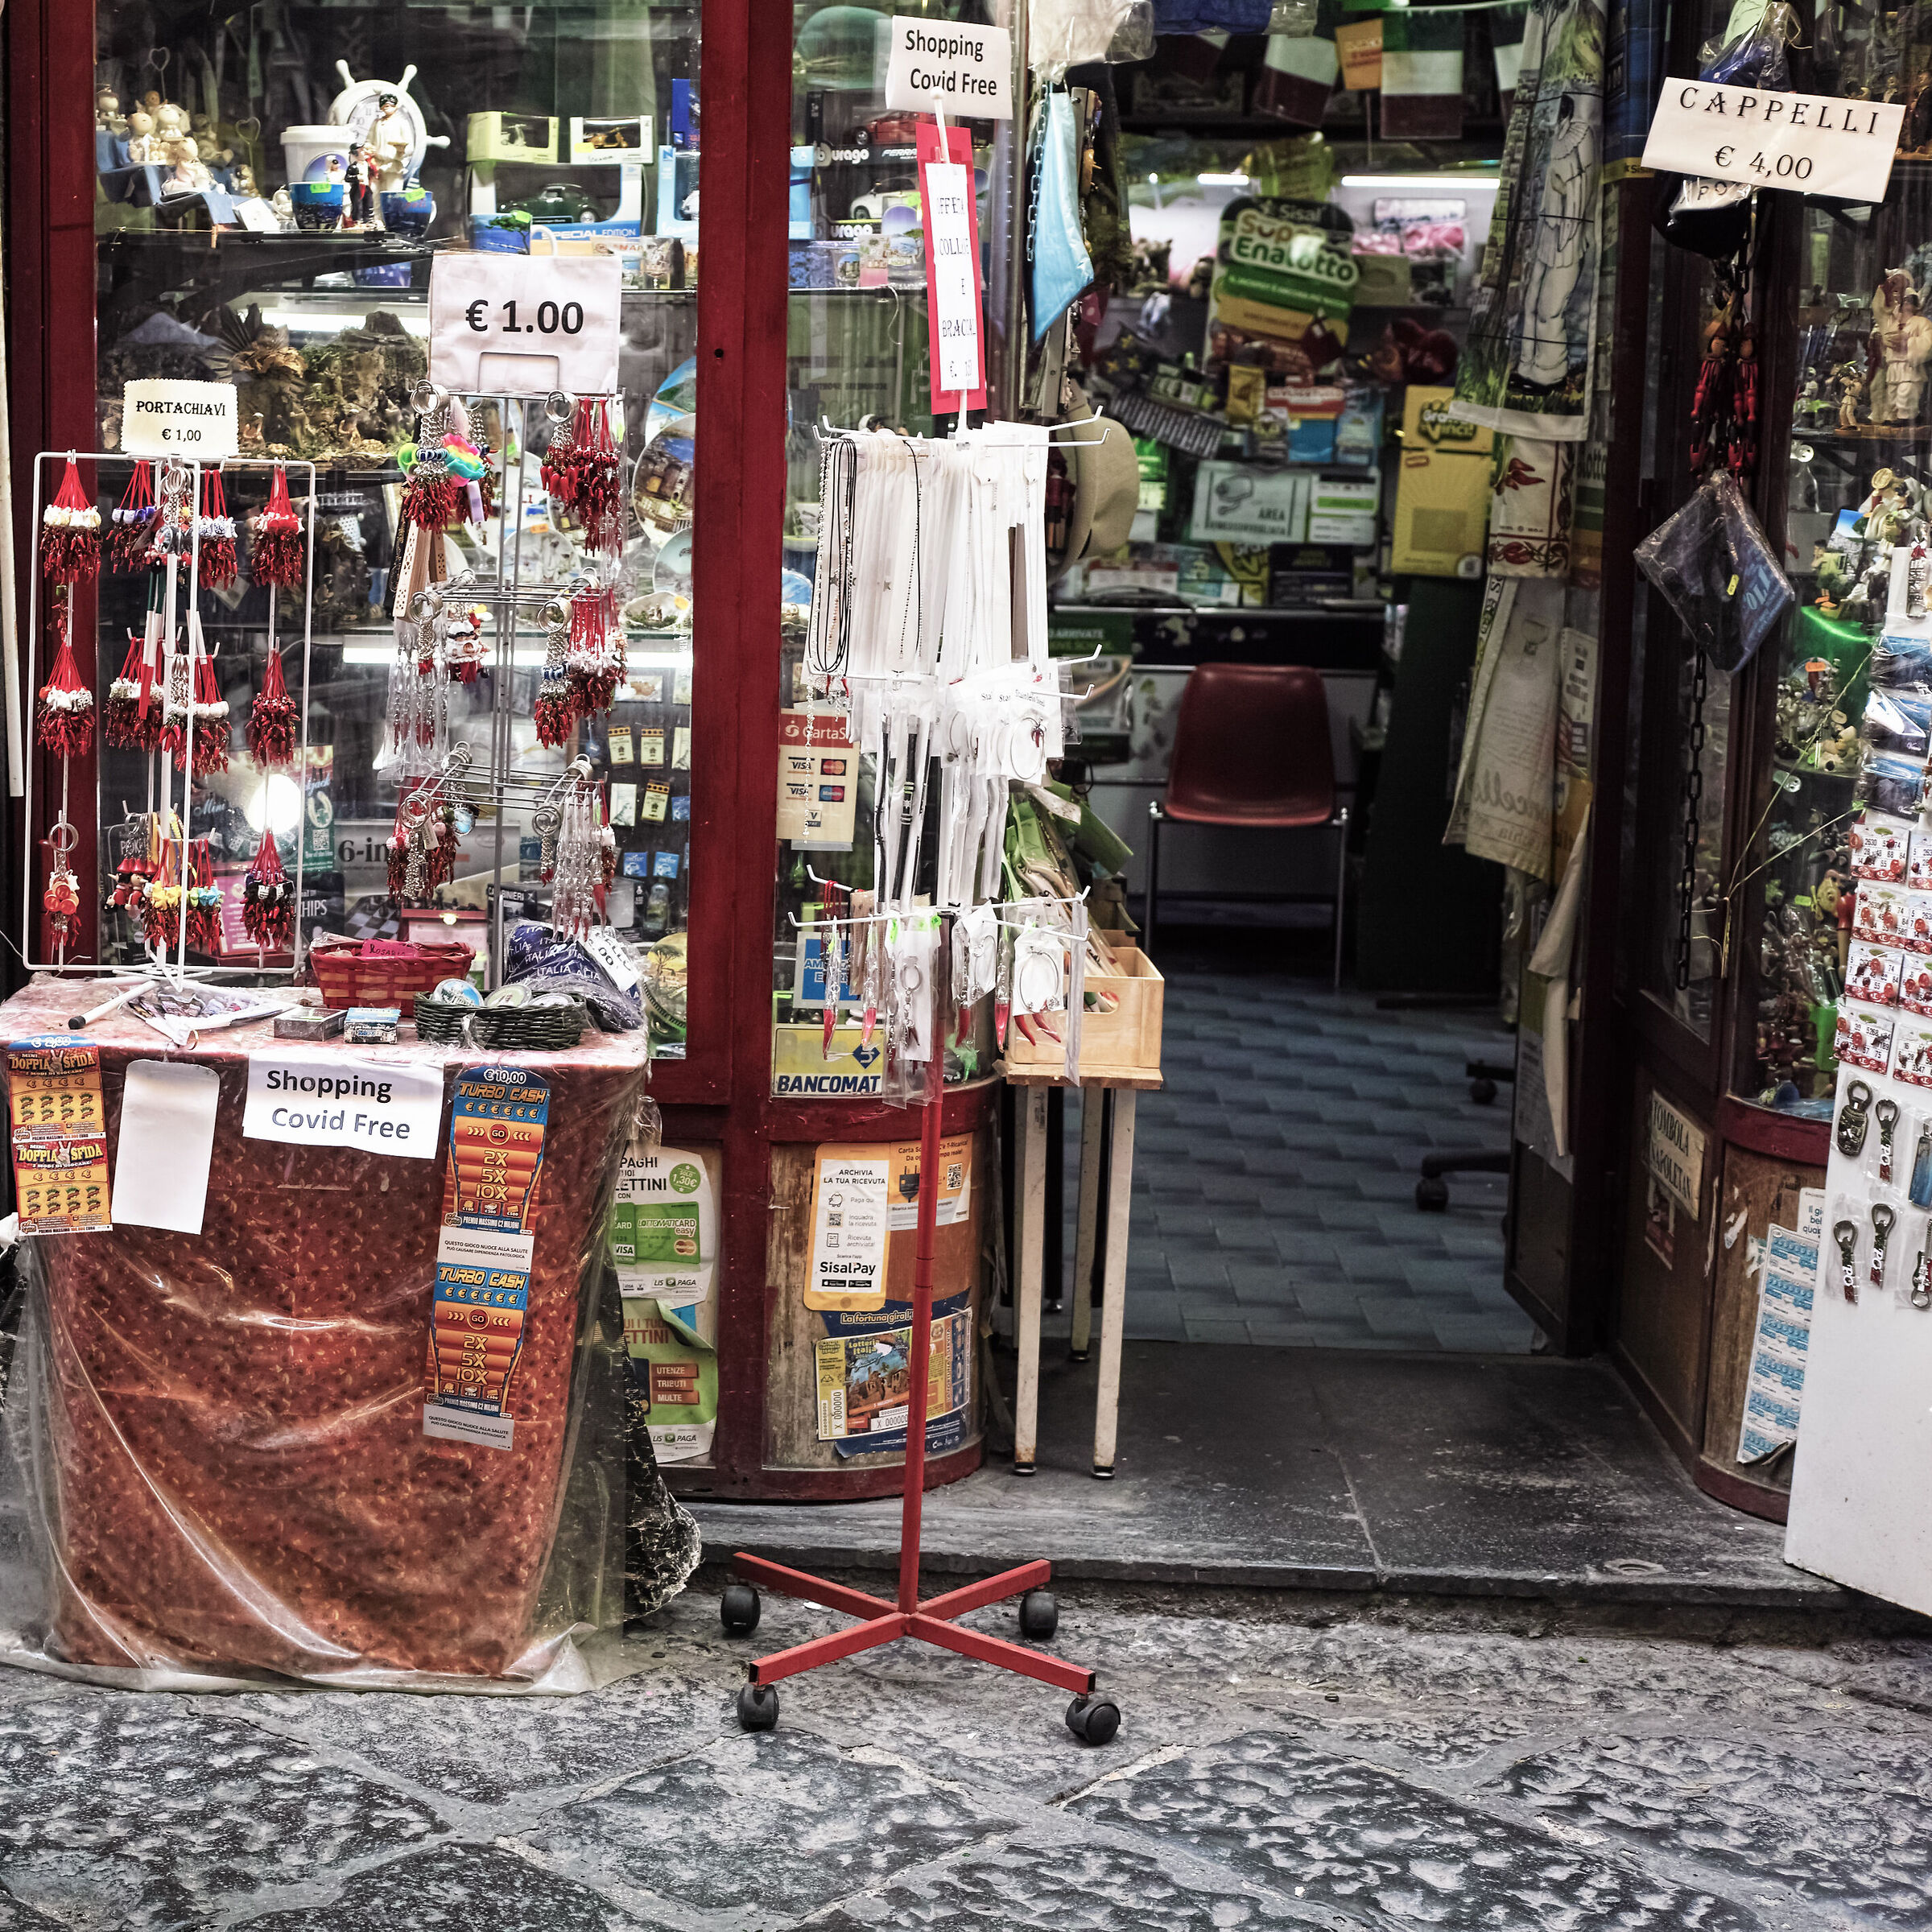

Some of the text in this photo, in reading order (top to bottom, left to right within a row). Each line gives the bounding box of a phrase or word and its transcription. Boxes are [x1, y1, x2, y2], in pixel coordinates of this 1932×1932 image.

[905, 29, 984, 63] Shopping
[910, 68, 997, 96] Covid Free
[1679, 86, 1879, 135] CAPPELLI
[1714, 145, 1813, 180] € 4,00
[465, 299, 584, 335] € 1.00
[135, 400, 226, 417] PORTACHIAVI
[162, 428, 201, 442] € 1,00
[11, 1052, 96, 1070] DOPPIA SFIDA
[266, 1070, 392, 1104] Shopping
[777, 1075, 881, 1093] BANCOMAT
[459, 1082, 547, 1104] TURBO CASH
[271, 1108, 411, 1140] Covid Free
[1653, 1100, 1689, 1158] TOMBOLA
[491, 1129, 505, 1137] GO
[19, 1143, 104, 1162] DOPPIA SFIDA
[484, 1150, 509, 1167] 2X
[620, 1157, 658, 1169] PAGHI
[481, 1168, 508, 1185] 5X
[476, 1184, 509, 1201] 10X
[850, 1196, 865, 1204] Paga
[675, 1227, 696, 1237] easy
[819, 1261, 877, 1276] SisalPay
[439, 1266, 527, 1290] TURBO CASH
[471, 1315, 485, 1323] GO
[841, 1311, 906, 1324] La fortuna gira
[464, 1334, 489, 1352] 2X
[461, 1352, 487, 1368] 5X
[456, 1367, 489, 1385] 10X
[656, 1366, 685, 1375] UTENZE
[657, 1380, 687, 1388] TRIBUTI
[657, 1393, 683, 1402] MULTE
